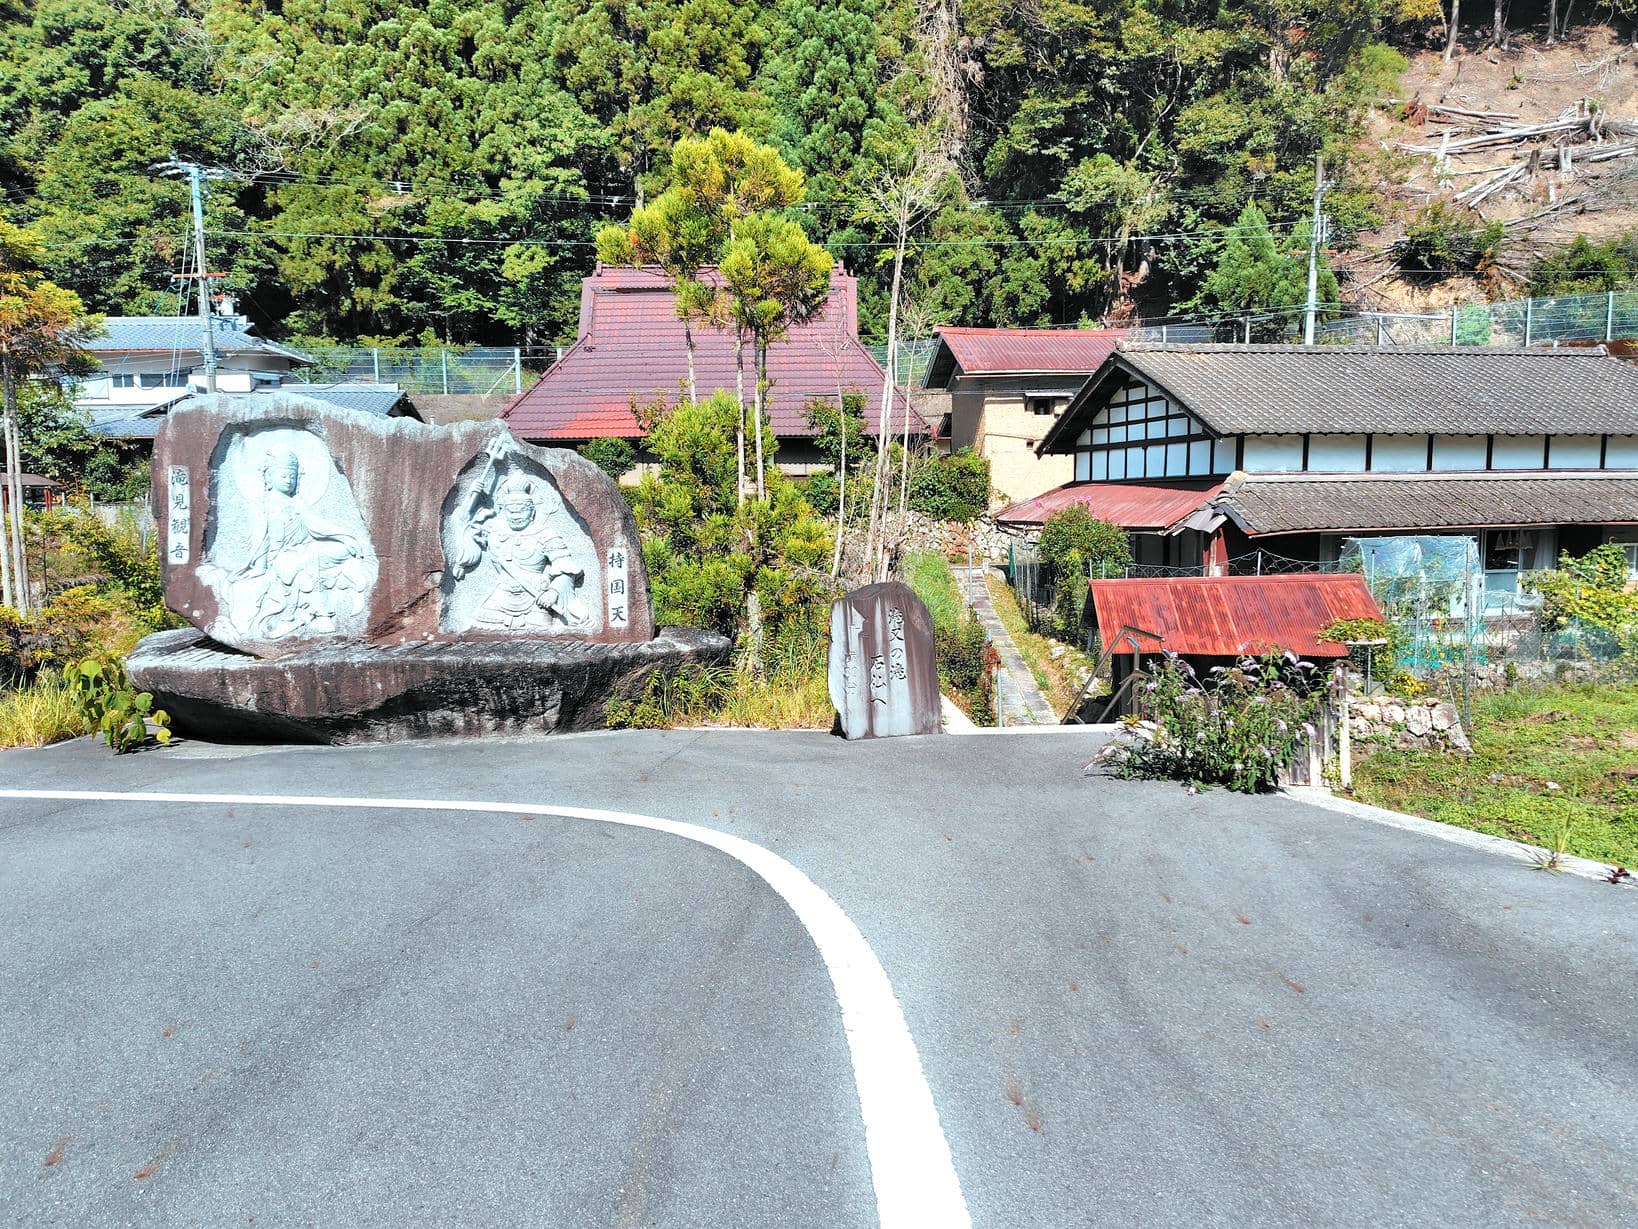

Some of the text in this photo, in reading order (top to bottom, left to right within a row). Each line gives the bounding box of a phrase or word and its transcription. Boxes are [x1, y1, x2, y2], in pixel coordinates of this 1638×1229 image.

[170, 468, 189, 559] 滝見観音
[608, 552, 627, 622] 持国天
